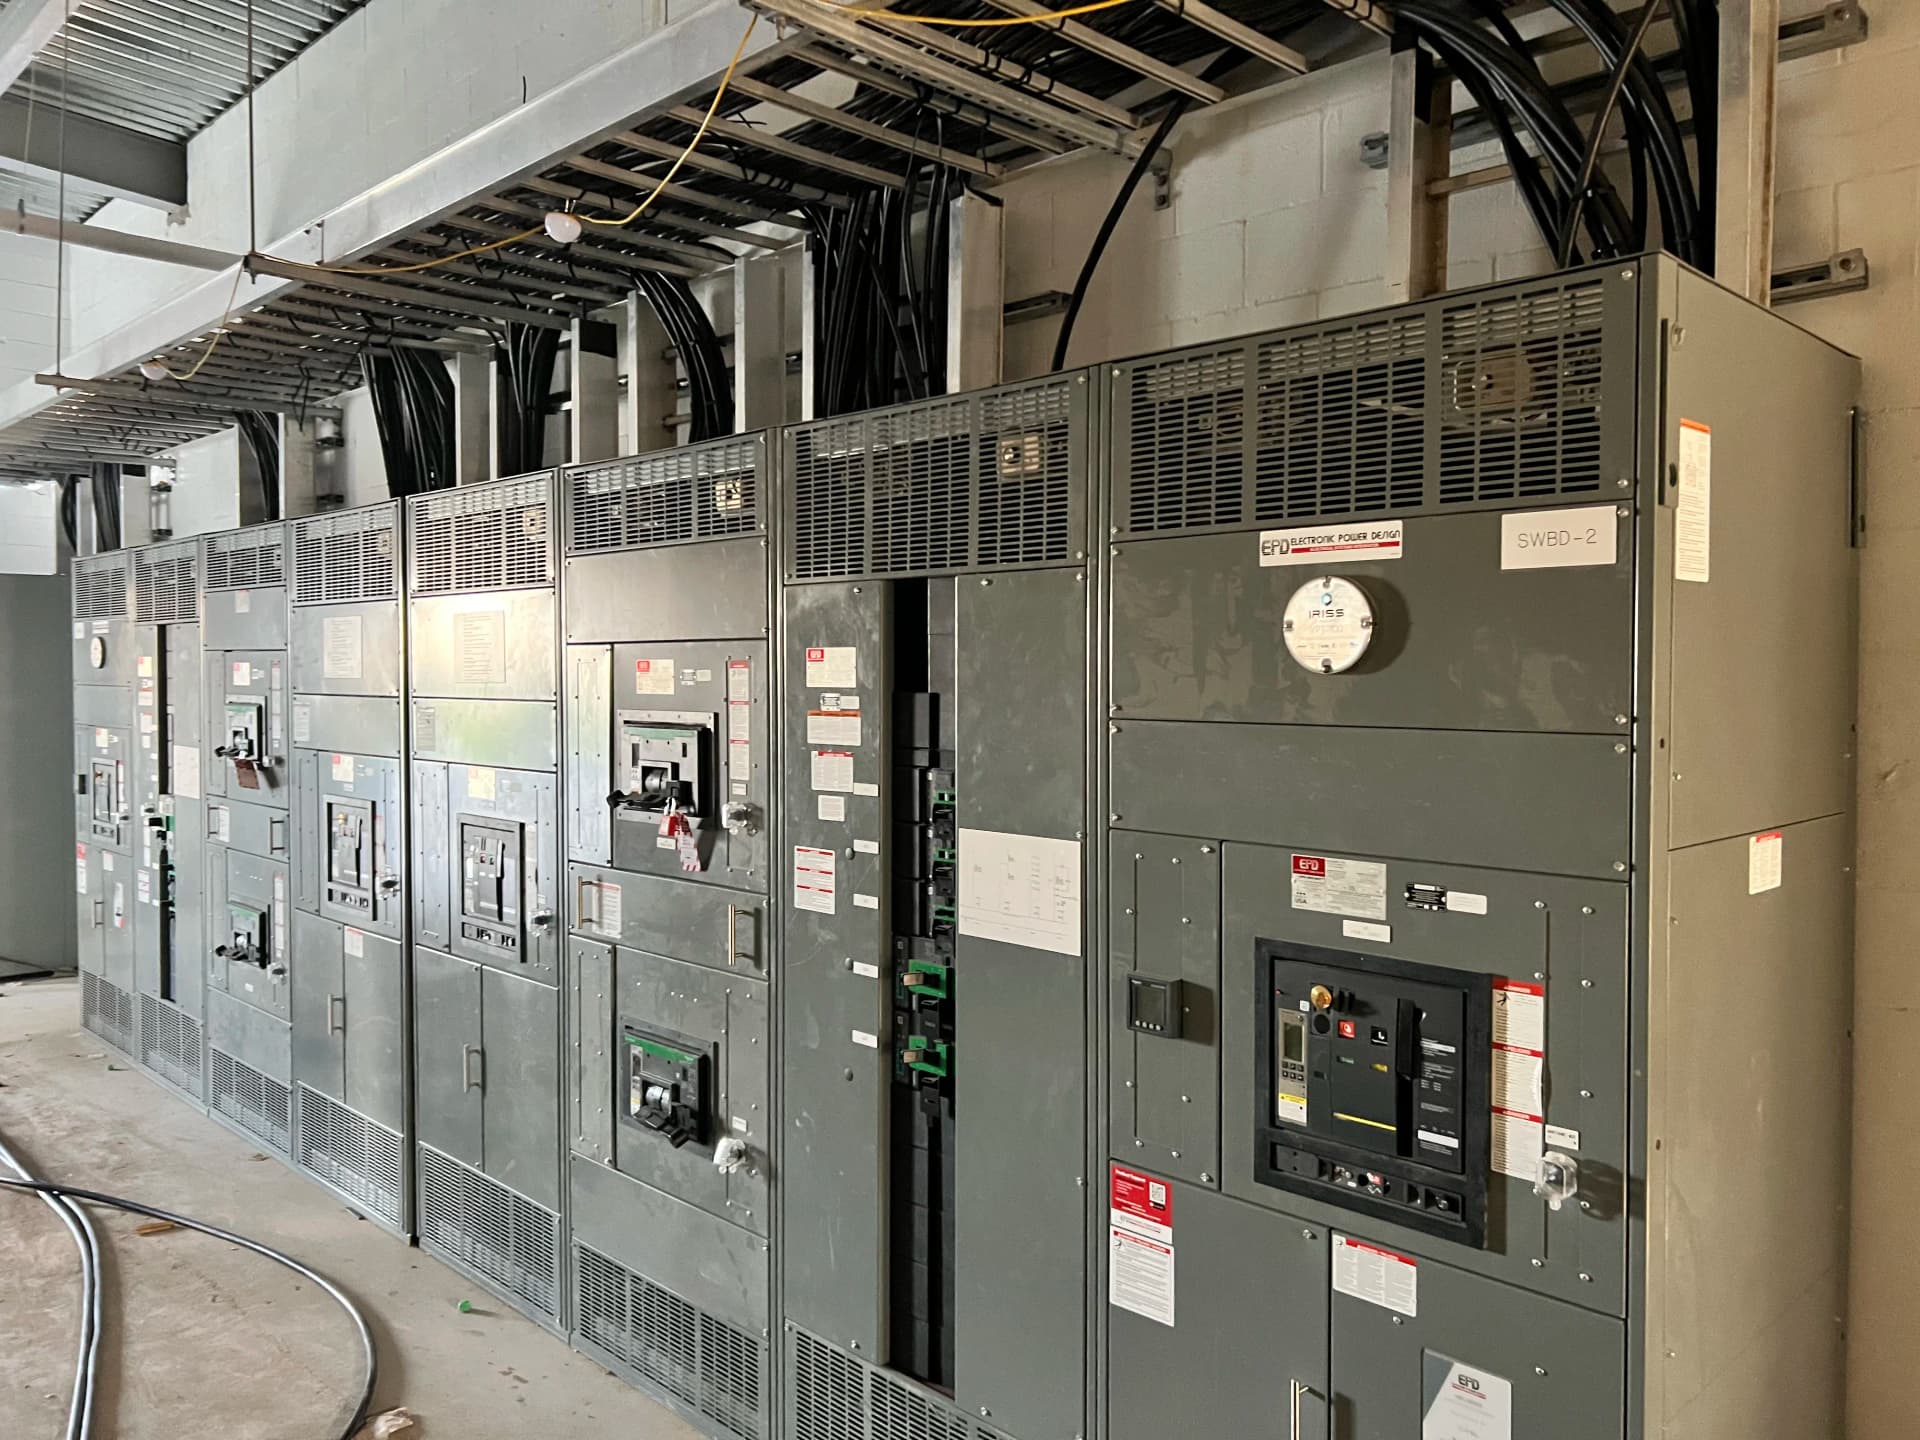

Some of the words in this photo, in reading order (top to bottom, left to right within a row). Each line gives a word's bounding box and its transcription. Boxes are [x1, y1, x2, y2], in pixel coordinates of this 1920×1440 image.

[1291, 534, 1335, 545] ELECTRONIC
[1338, 532, 1368, 542] POWER
[1371, 530, 1400, 539] DESIGN
[1517, 528, 1597, 549] SWBD-2
[1261, 539, 1290, 556] EPD
[1308, 608, 1345, 619] IRISS
[1299, 859, 1319, 870] EPD
[1458, 1375, 1480, 1390] EPD
